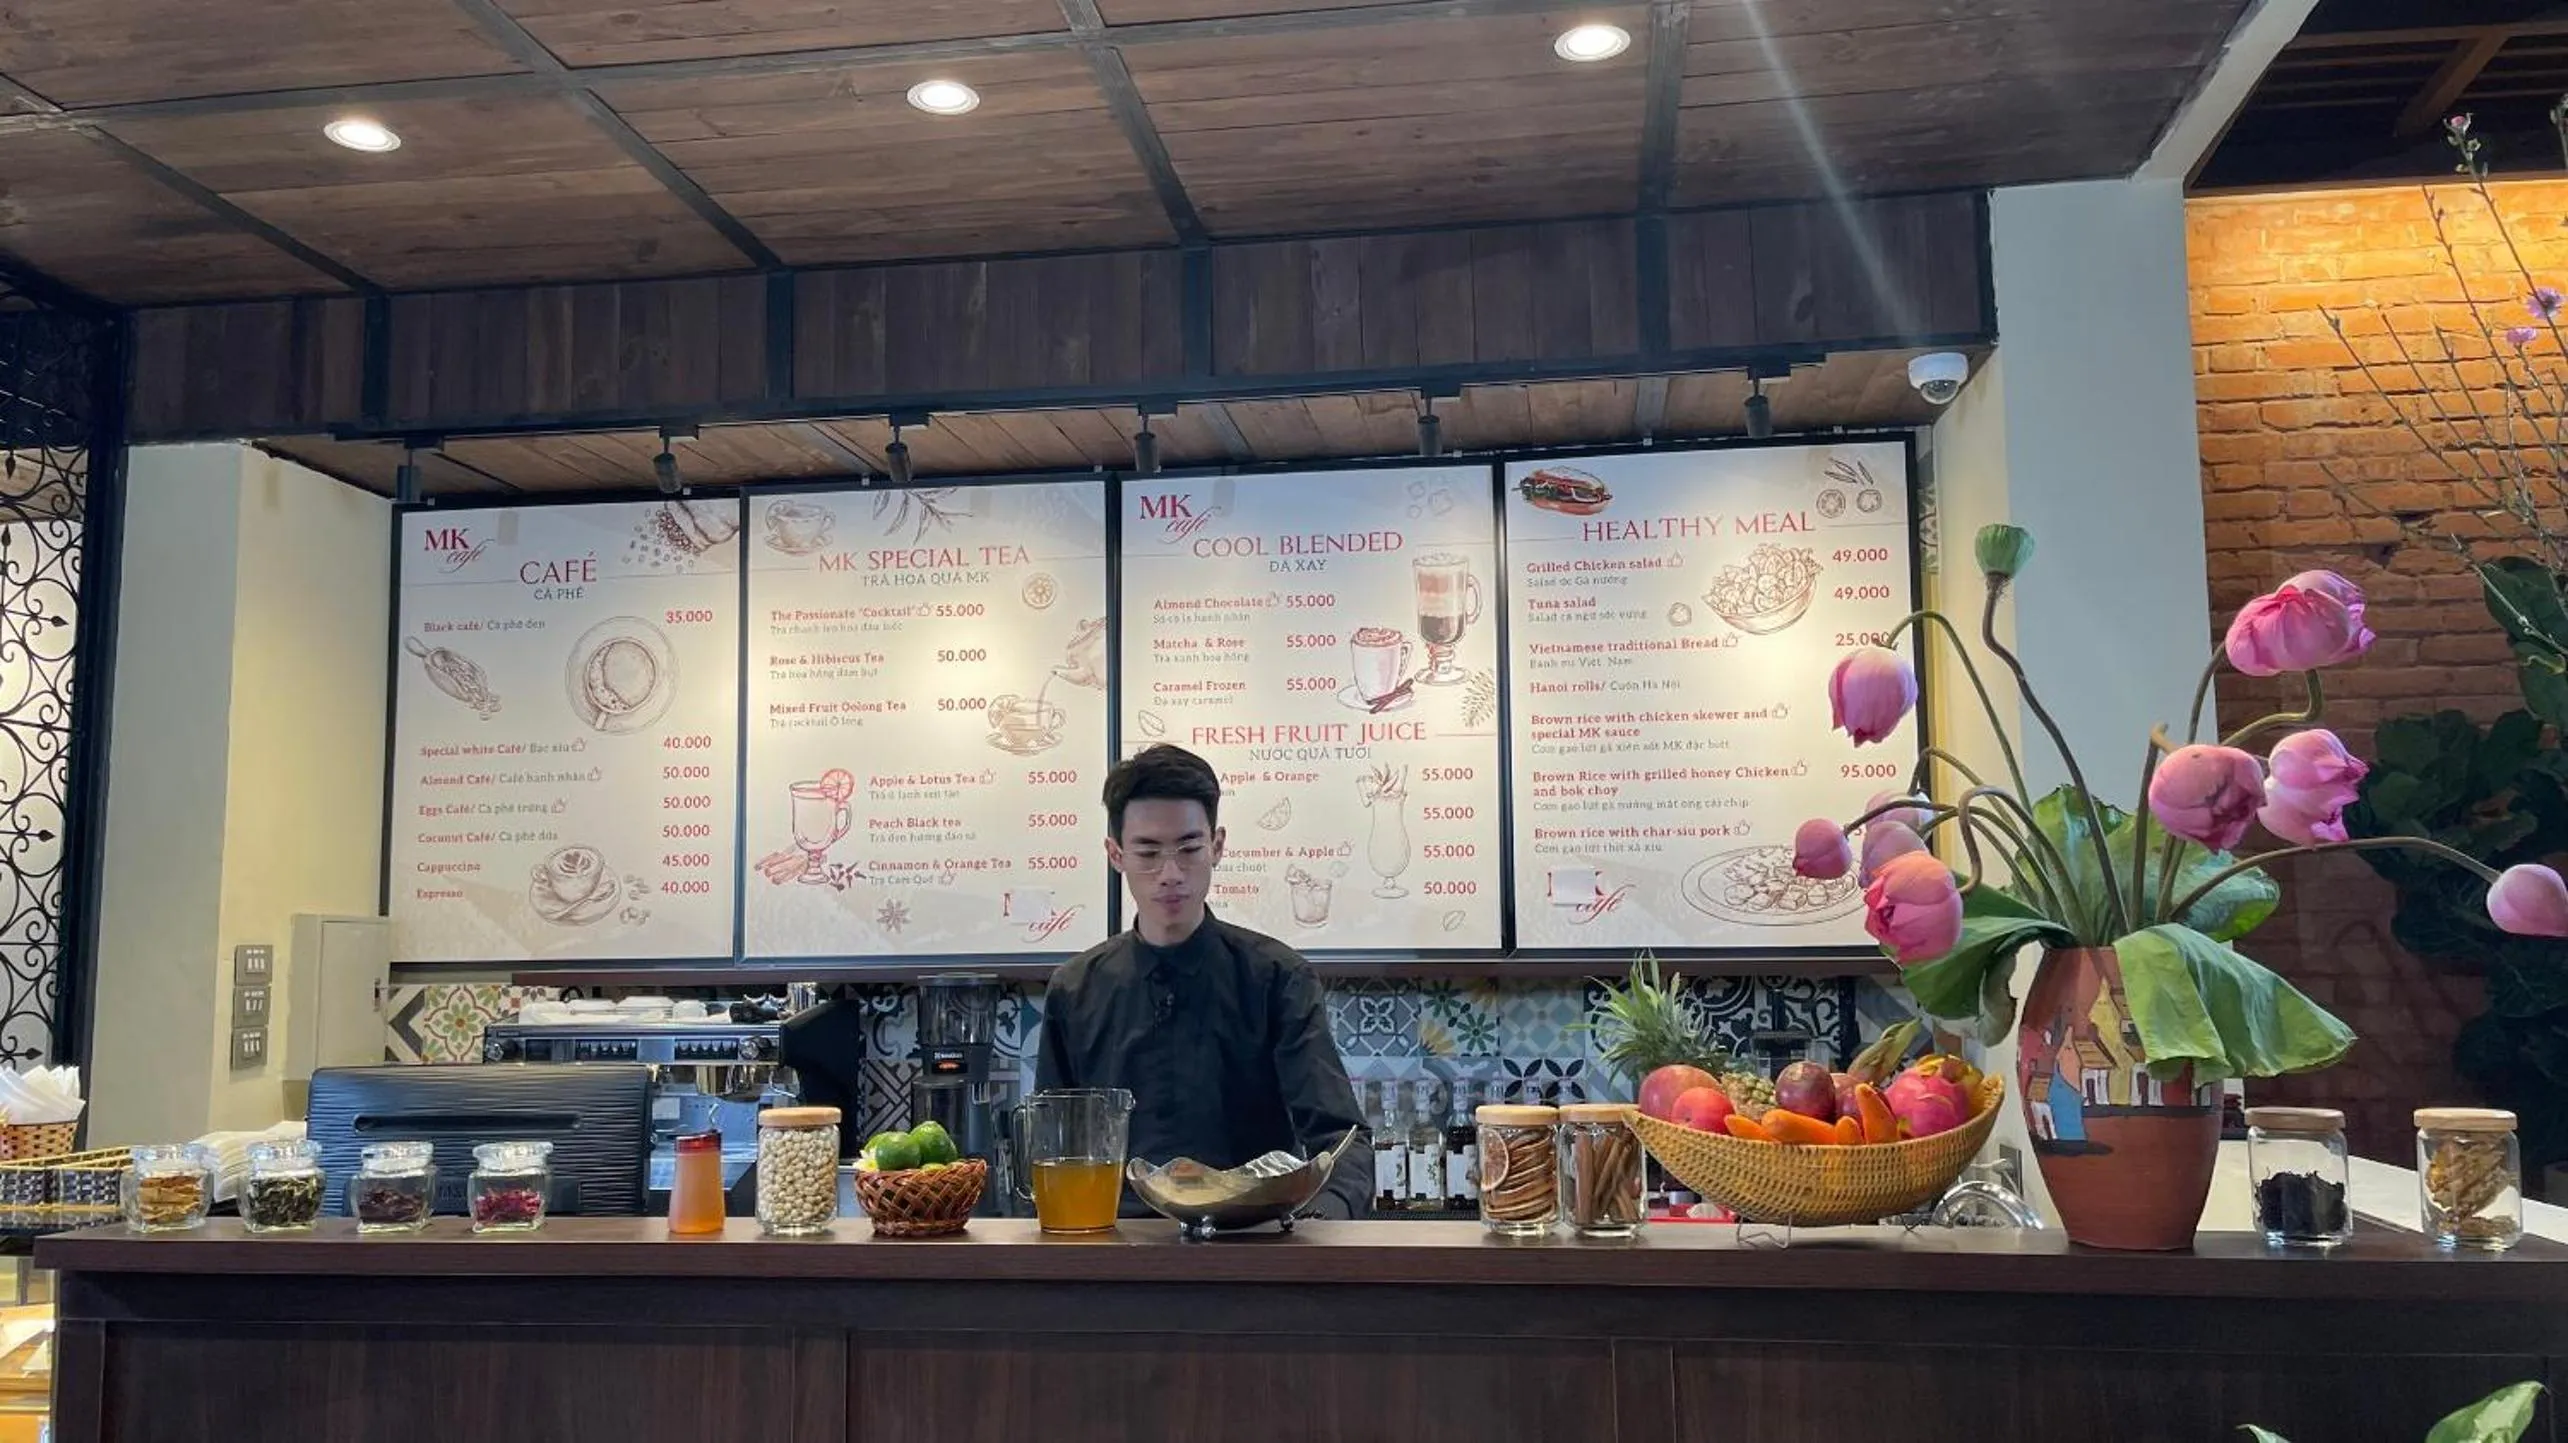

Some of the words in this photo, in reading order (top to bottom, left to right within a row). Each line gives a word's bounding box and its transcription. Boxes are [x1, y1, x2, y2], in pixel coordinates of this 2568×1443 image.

[1139, 493, 1192, 520] MK
[1583, 516, 1726, 543] HEALTHY
[1735, 510, 1816, 534] MEAL
[424, 528, 470, 551] MK
[1193, 537, 1269, 558] COOL
[1279, 531, 1404, 556] BLENDED
[819, 552, 858, 573] MK
[868, 548, 969, 571] SPECIAL
[978, 546, 1031, 566] TEA
[1832, 548, 1889, 563] 49.000
[519, 551, 598, 585] CAFÉ
[1294, 558, 1328, 572] XAY
[1526, 561, 1571, 574] Grilled
[1574, 559, 1626, 571] Chicken
[1629, 557, 1662, 569] salad
[1834, 585, 1890, 600] 49.000
[1154, 599, 1201, 611] Almond
[1204, 597, 1266, 609] Chocolate
[1286, 594, 1336, 608] 55.000
[1528, 598, 1560, 611] Tuna
[1563, 597, 1597, 609] salad
[665, 609, 713, 624] 35.000
[936, 603, 985, 617] 55.000
[1153, 638, 1198, 650] Matcha
[1204, 638, 1214, 648] &
[1217, 638, 1245, 649] Rose
[1286, 634, 1337, 648] 55.000
[1529, 642, 1605, 655] Vietnamese
[1608, 639, 1678, 652] traditional
[1681, 638, 1719, 650] Bread
[770, 655, 797, 666] Rose
[811, 653, 861, 665] Hibiscus
[863, 651, 885, 664] Tea
[937, 648, 987, 663] 50.000
[1153, 680, 1203, 692] Caramel
[1206, 680, 1246, 692] Frozen
[1286, 677, 1337, 691] 55.000
[1530, 681, 1568, 694] Hanoi
[1572, 680, 1606, 693] rolls/
[770, 703, 806, 715] Mixed
[809, 702, 838, 714] Fruit
[841, 701, 883, 713] Oolong
[887, 700, 907, 712] Tea
[937, 697, 987, 712] 50.000
[1531, 714, 1573, 726] Brown
[1577, 713, 1601, 724] rice
[1604, 712, 1635, 723] with
[1639, 710, 1689, 722] chicken
[1692, 708, 1739, 720] skewer
[1743, 707, 1768, 719] and
[1191, 726, 1265, 746] FRESH
[1274, 724, 1350, 744] FRUIT
[1356, 721, 1427, 745] JUICE
[1531, 727, 1575, 740] special
[1579, 727, 1601, 738] MK
[1604, 728, 1641, 738] sauce
[662, 736, 712, 750] 40.000
[662, 766, 711, 780] 50.000
[1027, 770, 1077, 785] 55.000
[1221, 772, 1256, 786] Apple
[1262, 771, 1272, 782] &
[1274, 770, 1320, 784] Orange
[1422, 767, 1474, 781] 55.000
[1533, 771, 1575, 783] Brown
[1579, 770, 1607, 781] Rice
[1609, 769, 1640, 781] with
[1644, 768, 1688, 782] grilled
[1691, 767, 1732, 780] honey
[1735, 766, 1790, 778] Chicken
[1840, 764, 1897, 778] 95.000
[420, 774, 464, 786] Almond
[869, 775, 905, 789] Apple
[907, 775, 916, 785] &
[920, 774, 952, 785] Lotus
[956, 773, 975, 784] Tea
[1533, 785, 1557, 797] and
[1560, 784, 1585, 796] bok
[1587, 784, 1619, 797] choy
[662, 796, 711, 809] 50.000
[1423, 806, 1475, 820] 55.000
[868, 818, 904, 829] Peach
[906, 817, 940, 828] Black
[943, 817, 962, 828] tea
[1028, 814, 1078, 828] 55.000
[662, 824, 711, 838] 50.000
[1533, 827, 1577, 840] Brown
[1580, 826, 1606, 838] rice
[1608, 825, 1640, 838] with
[1642, 824, 1697, 837] char-siu
[1699, 824, 1730, 838] pork
[1285, 846, 1294, 857] &
[1299, 846, 1334, 858] Apple
[1423, 843, 1476, 858] 55.000
[416, 861, 481, 874] Cappuccino
[662, 854, 711, 867] 45.000
[868, 860, 929, 871] Cinnamon
[944, 857, 988, 870] Orange
[991, 857, 1012, 869] Tea
[1028, 857, 1078, 870] 55.000
[416, 888, 463, 900] Espresso
[661, 881, 711, 894] 40.000
[1214, 884, 1259, 895] Tomato
[1423, 880, 1477, 896] 50.000
